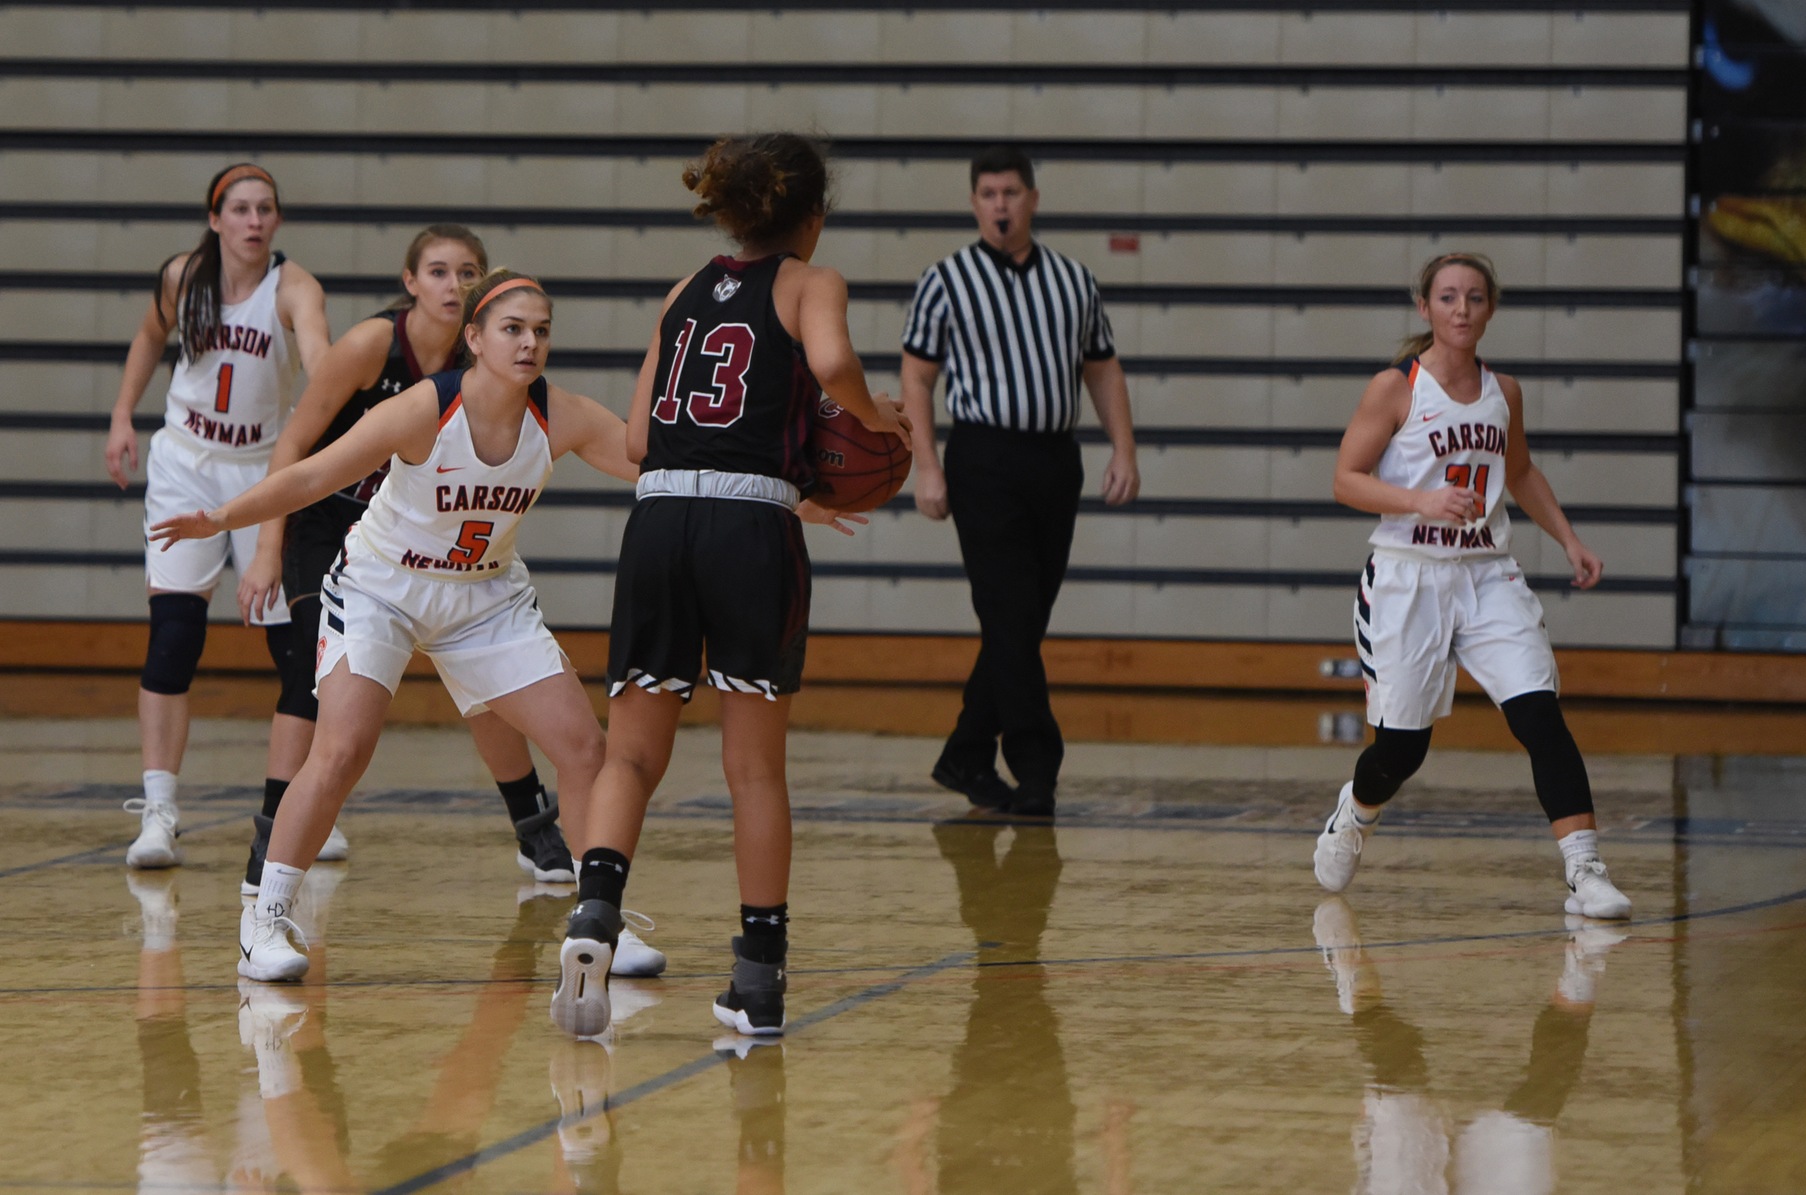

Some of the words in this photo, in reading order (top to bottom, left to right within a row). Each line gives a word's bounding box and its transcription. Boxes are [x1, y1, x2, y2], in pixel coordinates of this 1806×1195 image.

[214, 362, 234, 414] 1
[652, 317, 755, 428] 13
[184, 406, 262, 448] NEWMAN
[1429, 422, 1507, 458] CARSON
[436, 485, 537, 515] CARSON
[447, 520, 495, 565] 5
